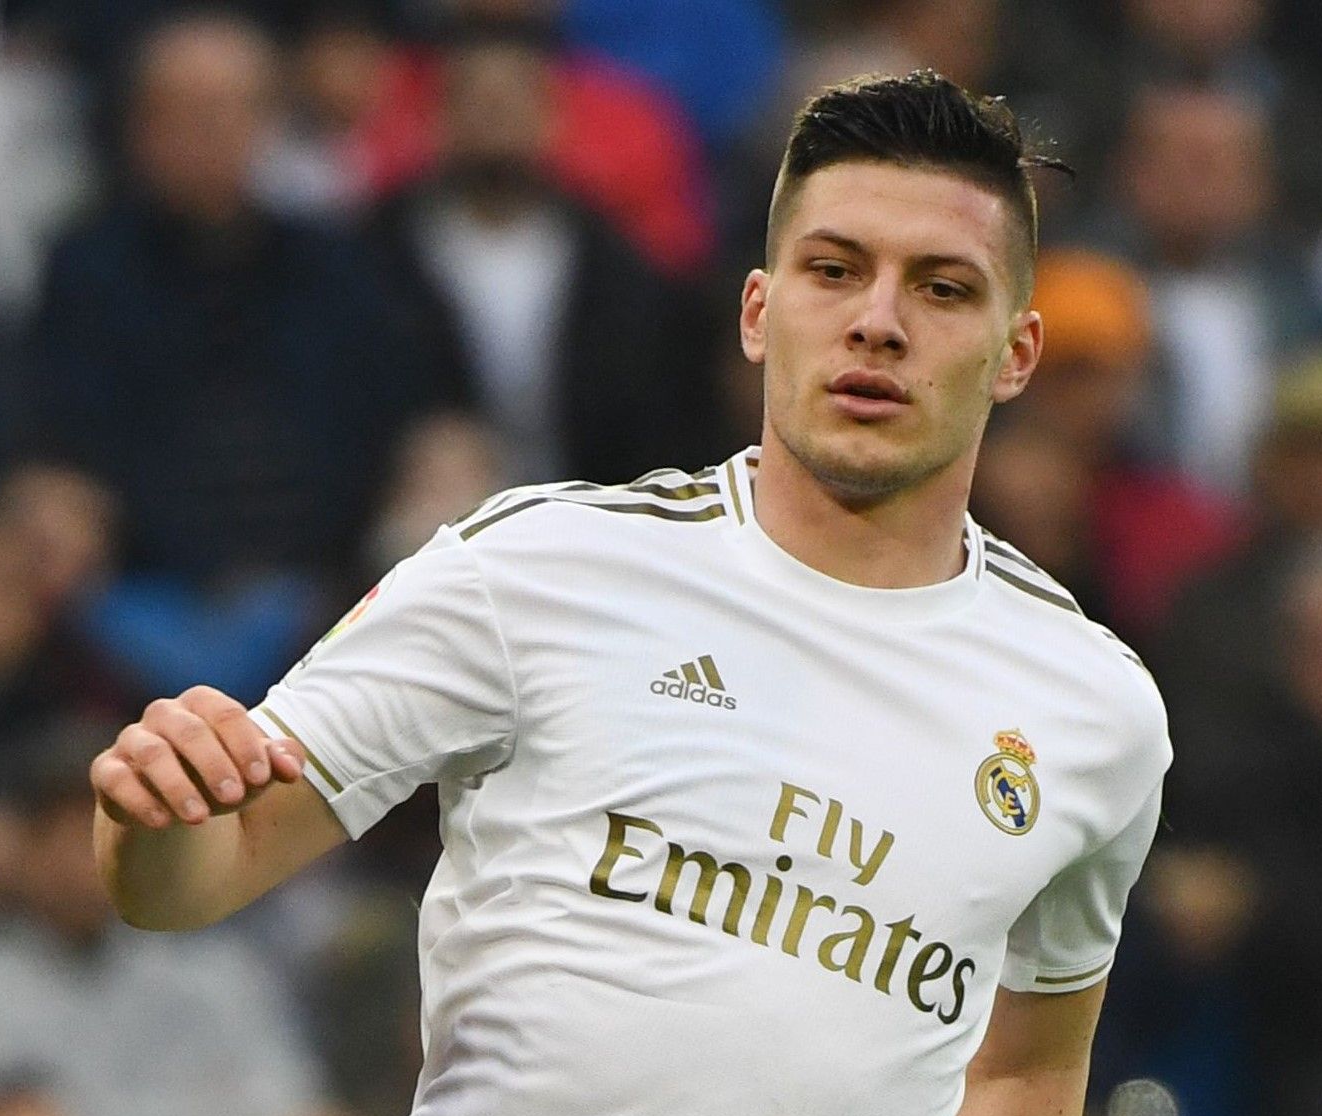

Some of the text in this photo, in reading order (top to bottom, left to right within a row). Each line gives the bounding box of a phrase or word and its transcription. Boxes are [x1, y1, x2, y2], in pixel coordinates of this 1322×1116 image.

[650, 680, 737, 710] adidas
[769, 782, 895, 887] Fly
[589, 811, 976, 1025] Emirates
